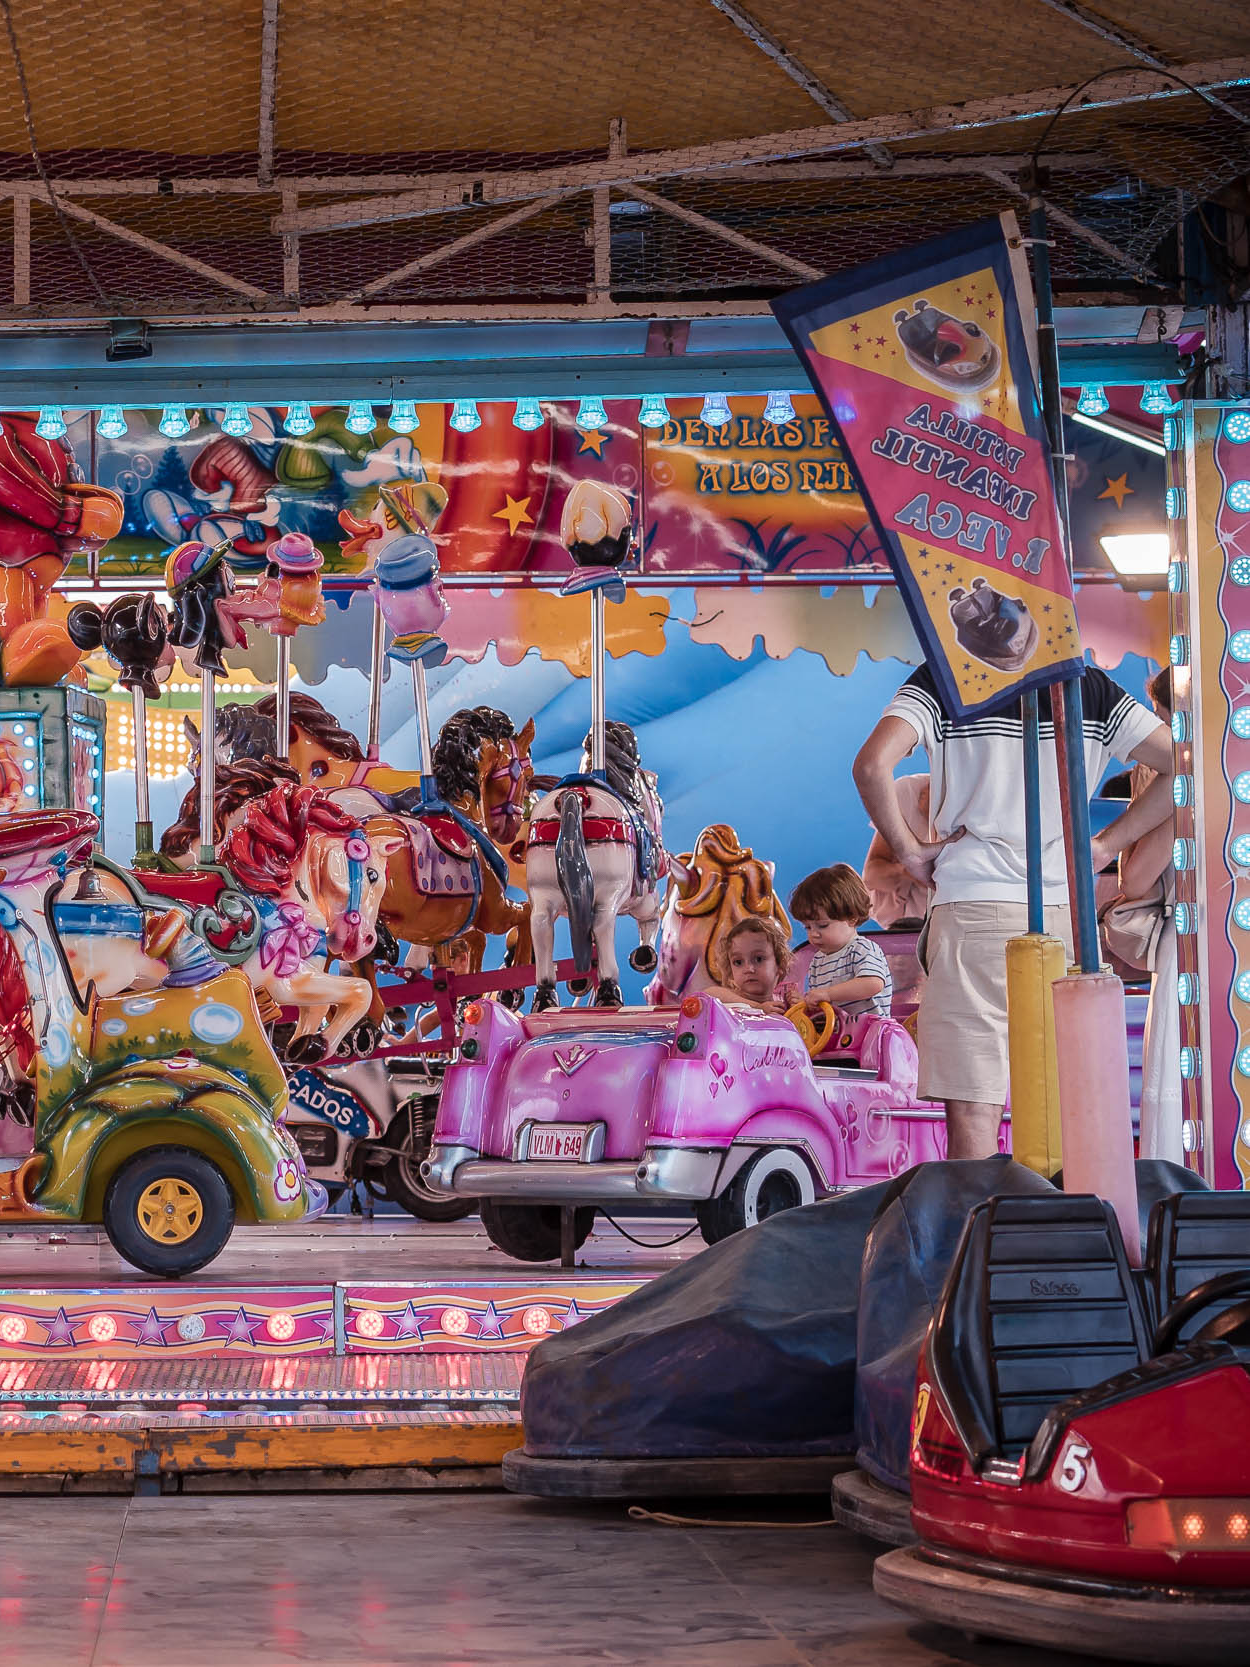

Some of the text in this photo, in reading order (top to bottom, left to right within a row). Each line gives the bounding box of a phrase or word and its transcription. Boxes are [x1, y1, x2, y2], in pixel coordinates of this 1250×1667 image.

[660, 418, 730, 446] DEN
[738, 418, 803, 446] LAS
[699, 463, 722, 492] A
[730, 462, 790, 492] LOS
[533, 1135, 582, 1156] VLM 649
[1059, 1444, 1089, 1492] 5
